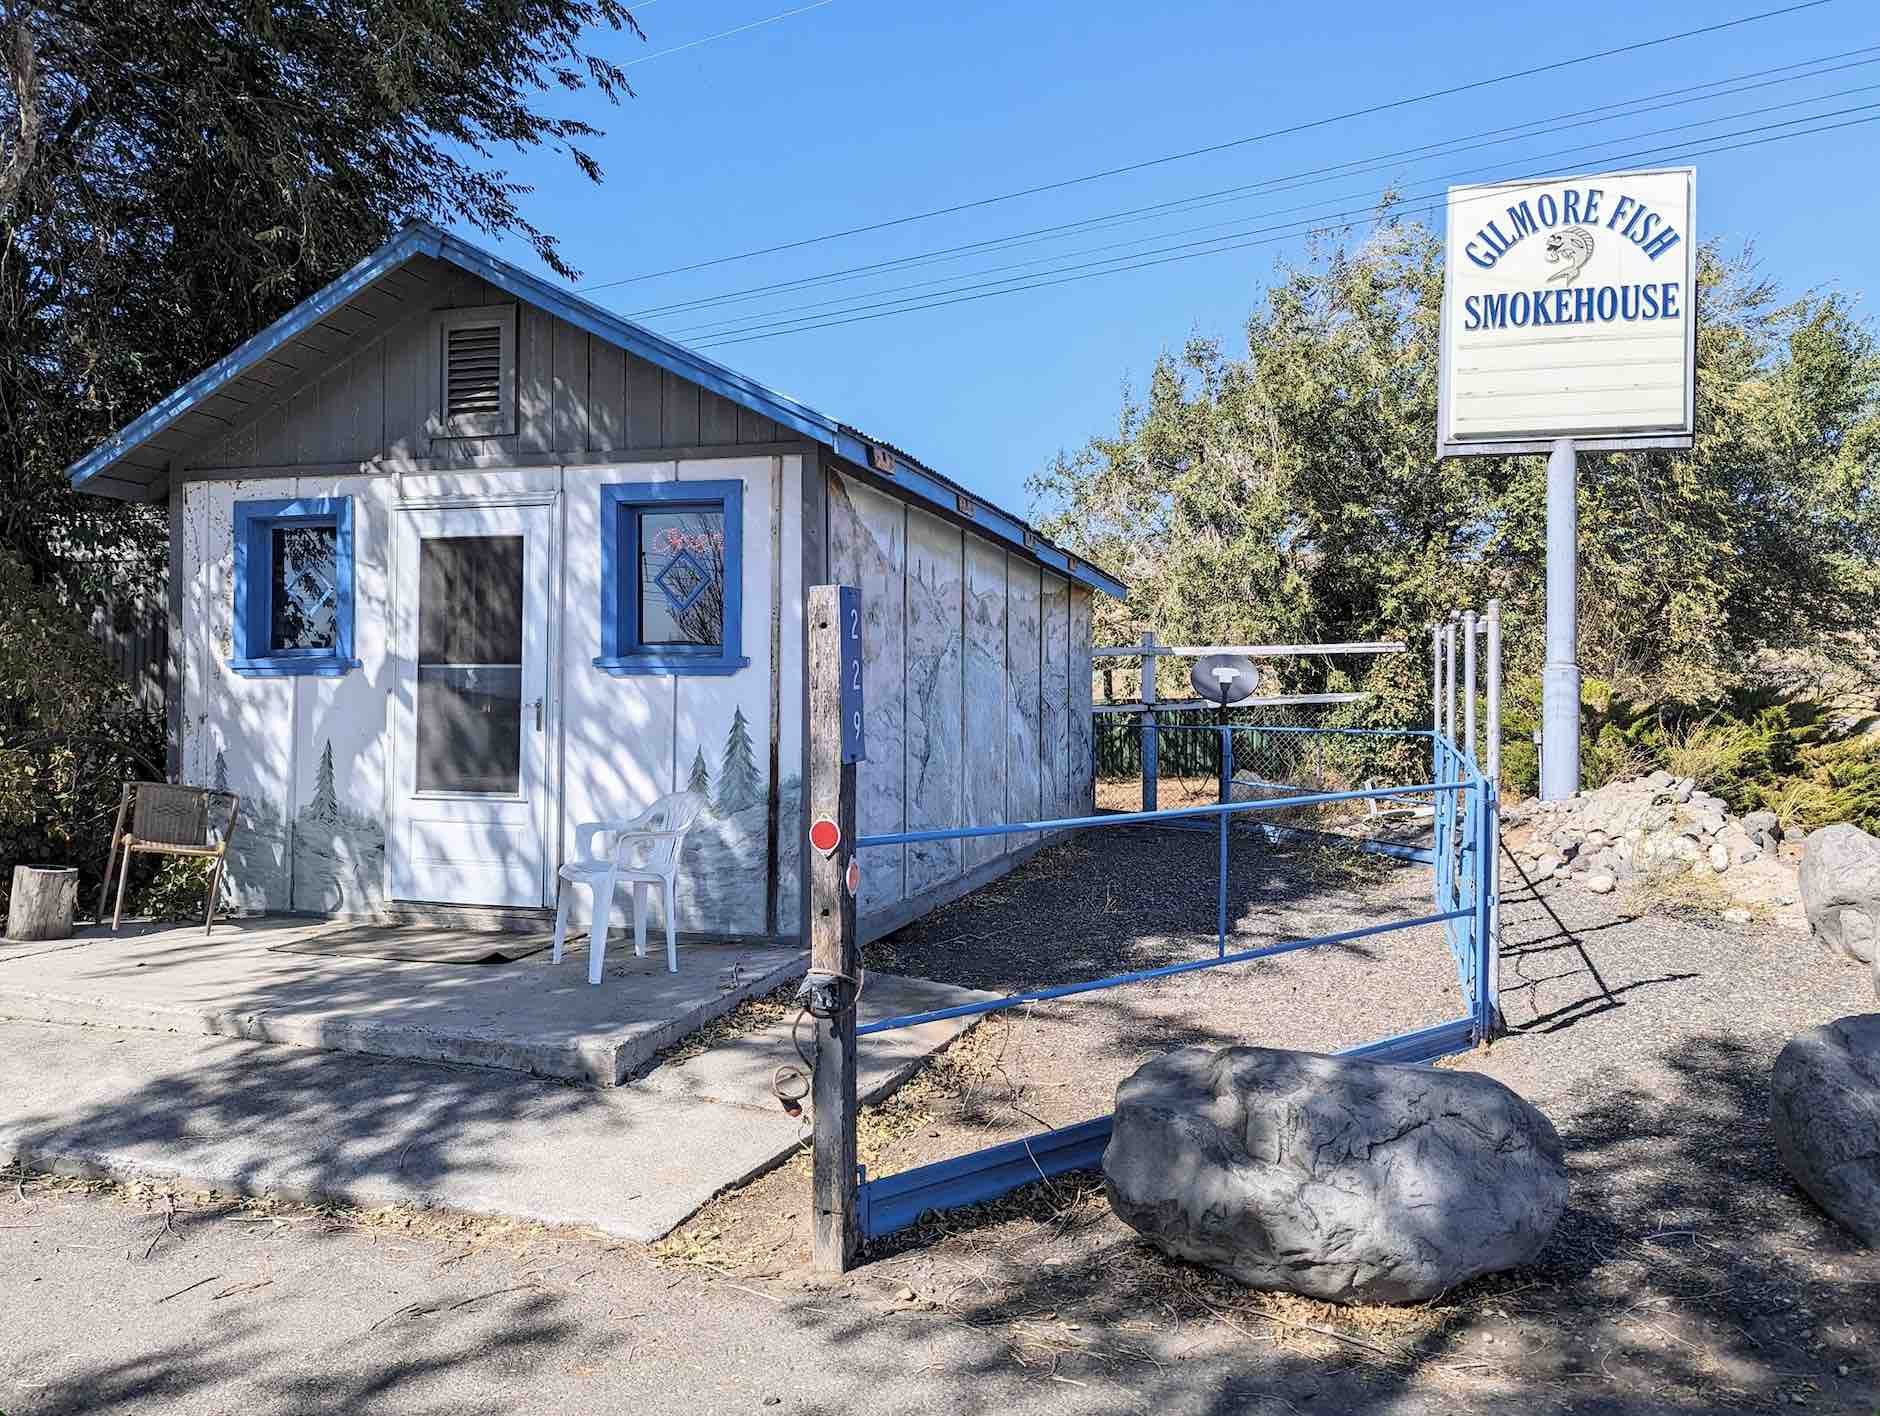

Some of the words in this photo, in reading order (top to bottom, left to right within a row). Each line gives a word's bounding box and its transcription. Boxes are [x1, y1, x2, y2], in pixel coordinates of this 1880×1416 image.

[1464, 189, 1604, 270] GILMORE
[1606, 195, 1681, 261] FISH
[1464, 283, 1681, 331] SMOKEHOUSE
